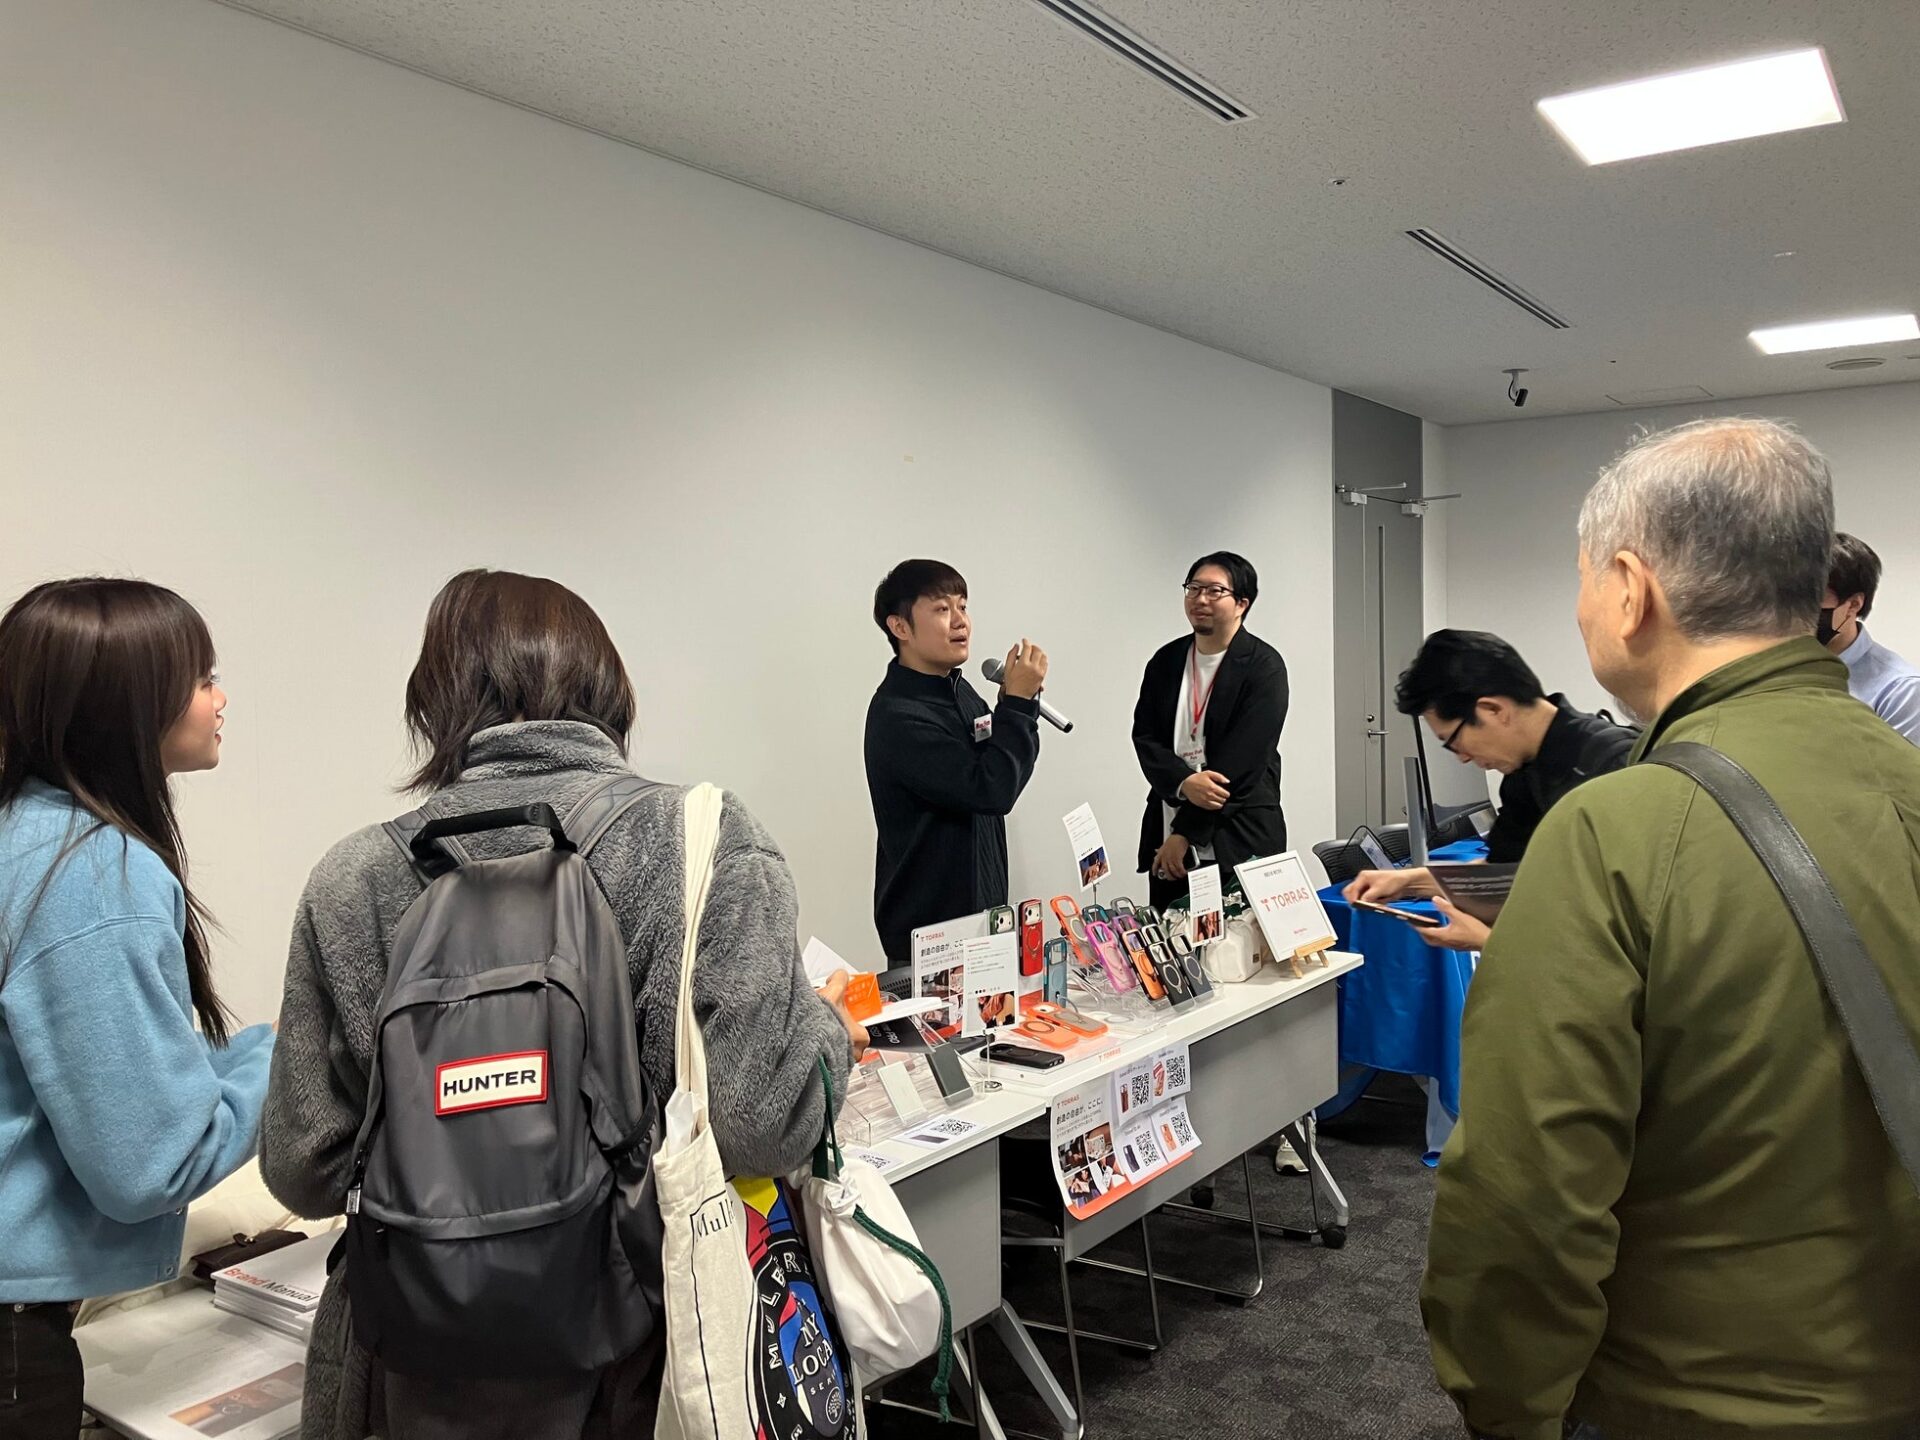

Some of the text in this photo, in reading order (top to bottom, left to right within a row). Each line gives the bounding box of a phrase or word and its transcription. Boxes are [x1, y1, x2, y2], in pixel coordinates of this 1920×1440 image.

[1270, 887, 1309, 909] TORRAS
[443, 1069, 537, 1097] HUNTER
[223, 1267, 320, 1302] Brand Manual
[800, 1312, 820, 1347] NY
